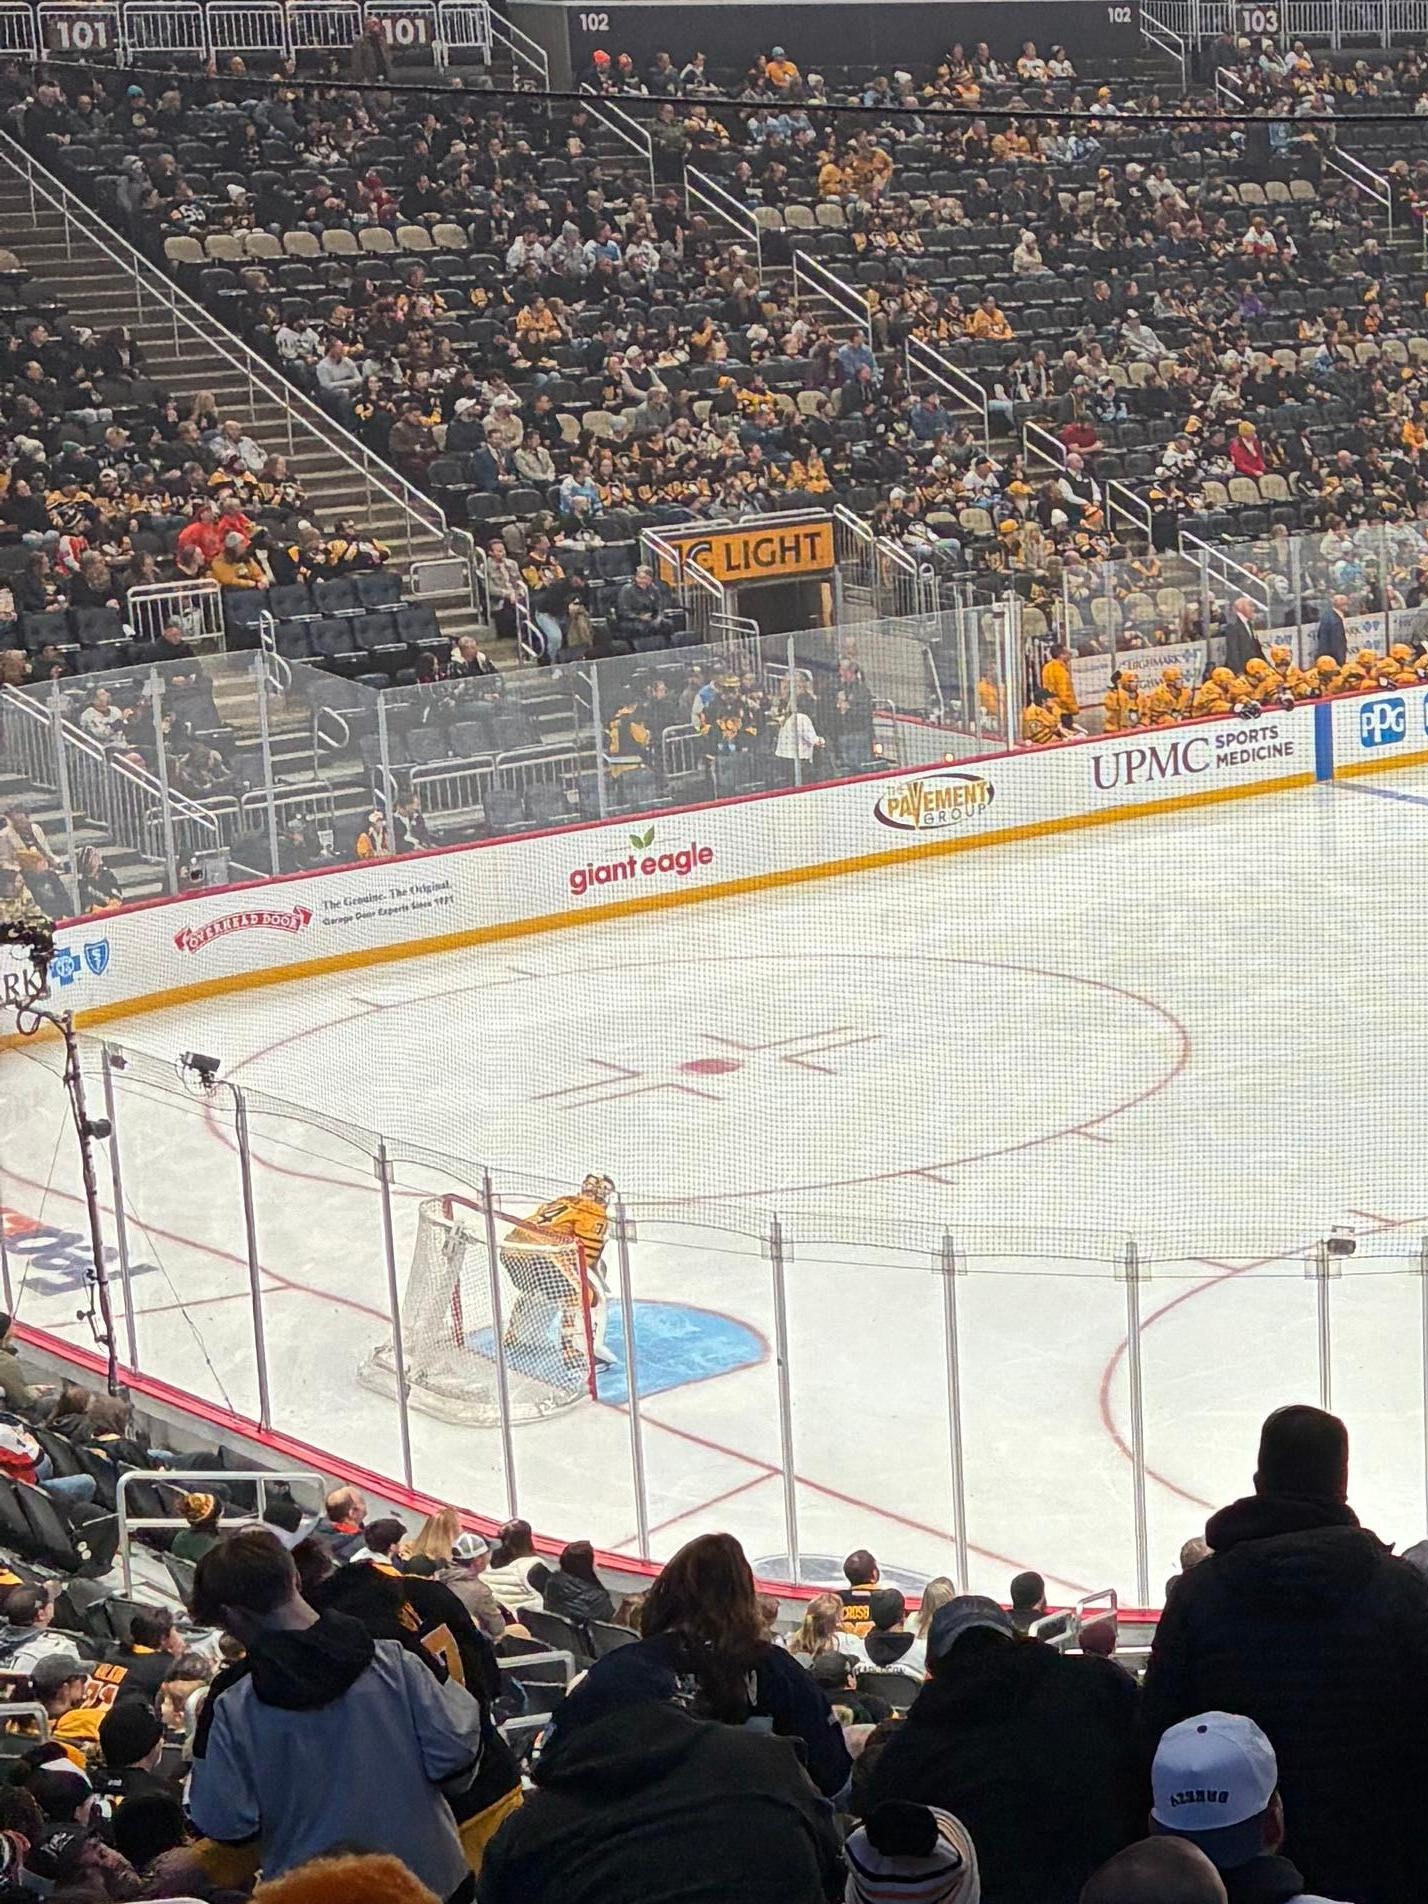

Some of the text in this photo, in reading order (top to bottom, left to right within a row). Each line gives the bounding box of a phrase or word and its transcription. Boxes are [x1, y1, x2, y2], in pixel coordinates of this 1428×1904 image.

[580, 12, 609, 31] 102
[1108, 7, 1131, 24] 102
[1242, 9, 1278, 34] 103
[56, 21, 108, 49] 101
[381, 18, 428, 45] 101
[724, 532, 822, 572] LIGHT
[1363, 700, 1404, 744] PPG
[1091, 726, 1279, 790] UPMC SPORTS
[1216, 741, 1294, 769] MEDICINE
[887, 782, 987, 825] PAVEMENT
[923, 804, 986, 825] GROUP
[569, 841, 713, 896] giant eagle
[261, 911, 299, 932] DOOR
